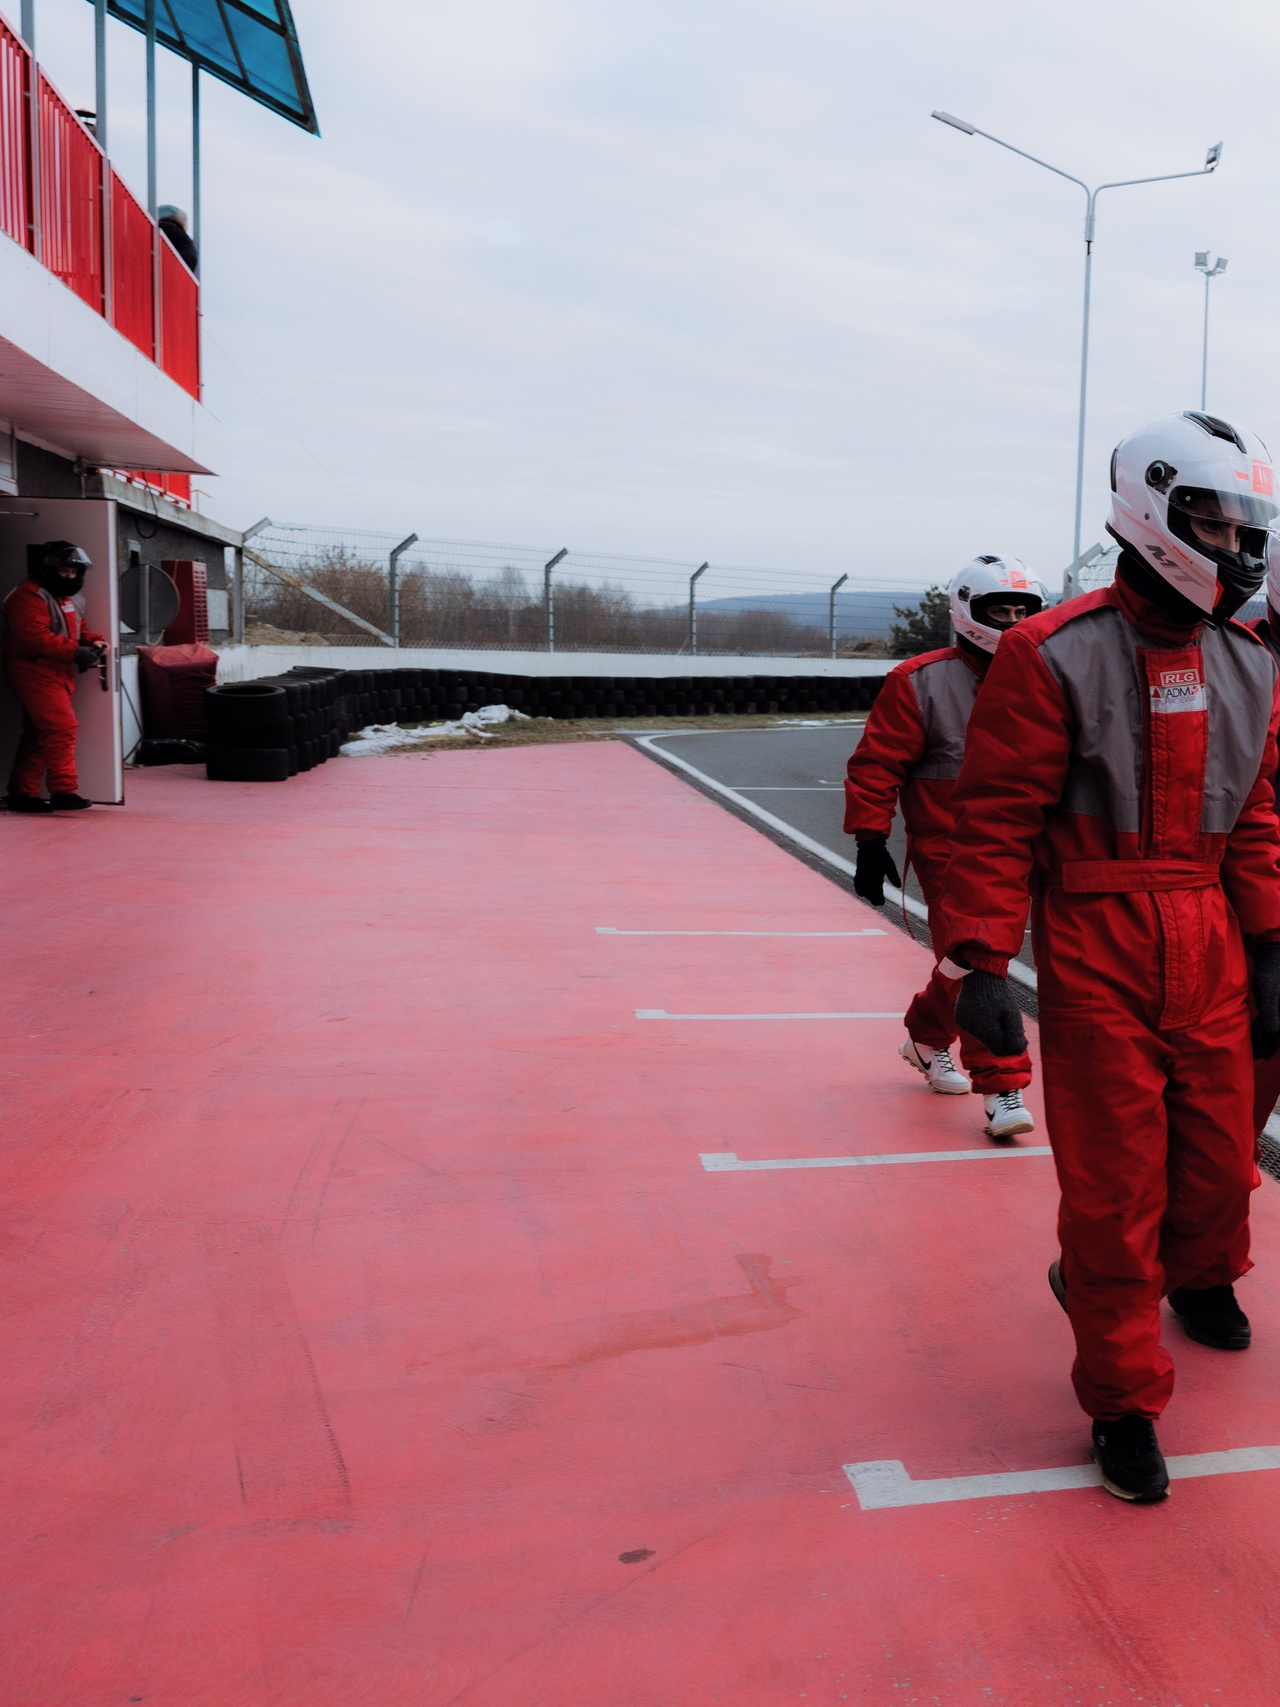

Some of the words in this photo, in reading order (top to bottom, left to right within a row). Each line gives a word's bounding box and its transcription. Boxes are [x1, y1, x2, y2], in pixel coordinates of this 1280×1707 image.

[1144, 544, 1208, 588] MT
[1165, 672, 1195, 684] RLG
[1165, 686, 1191, 698] ADM
